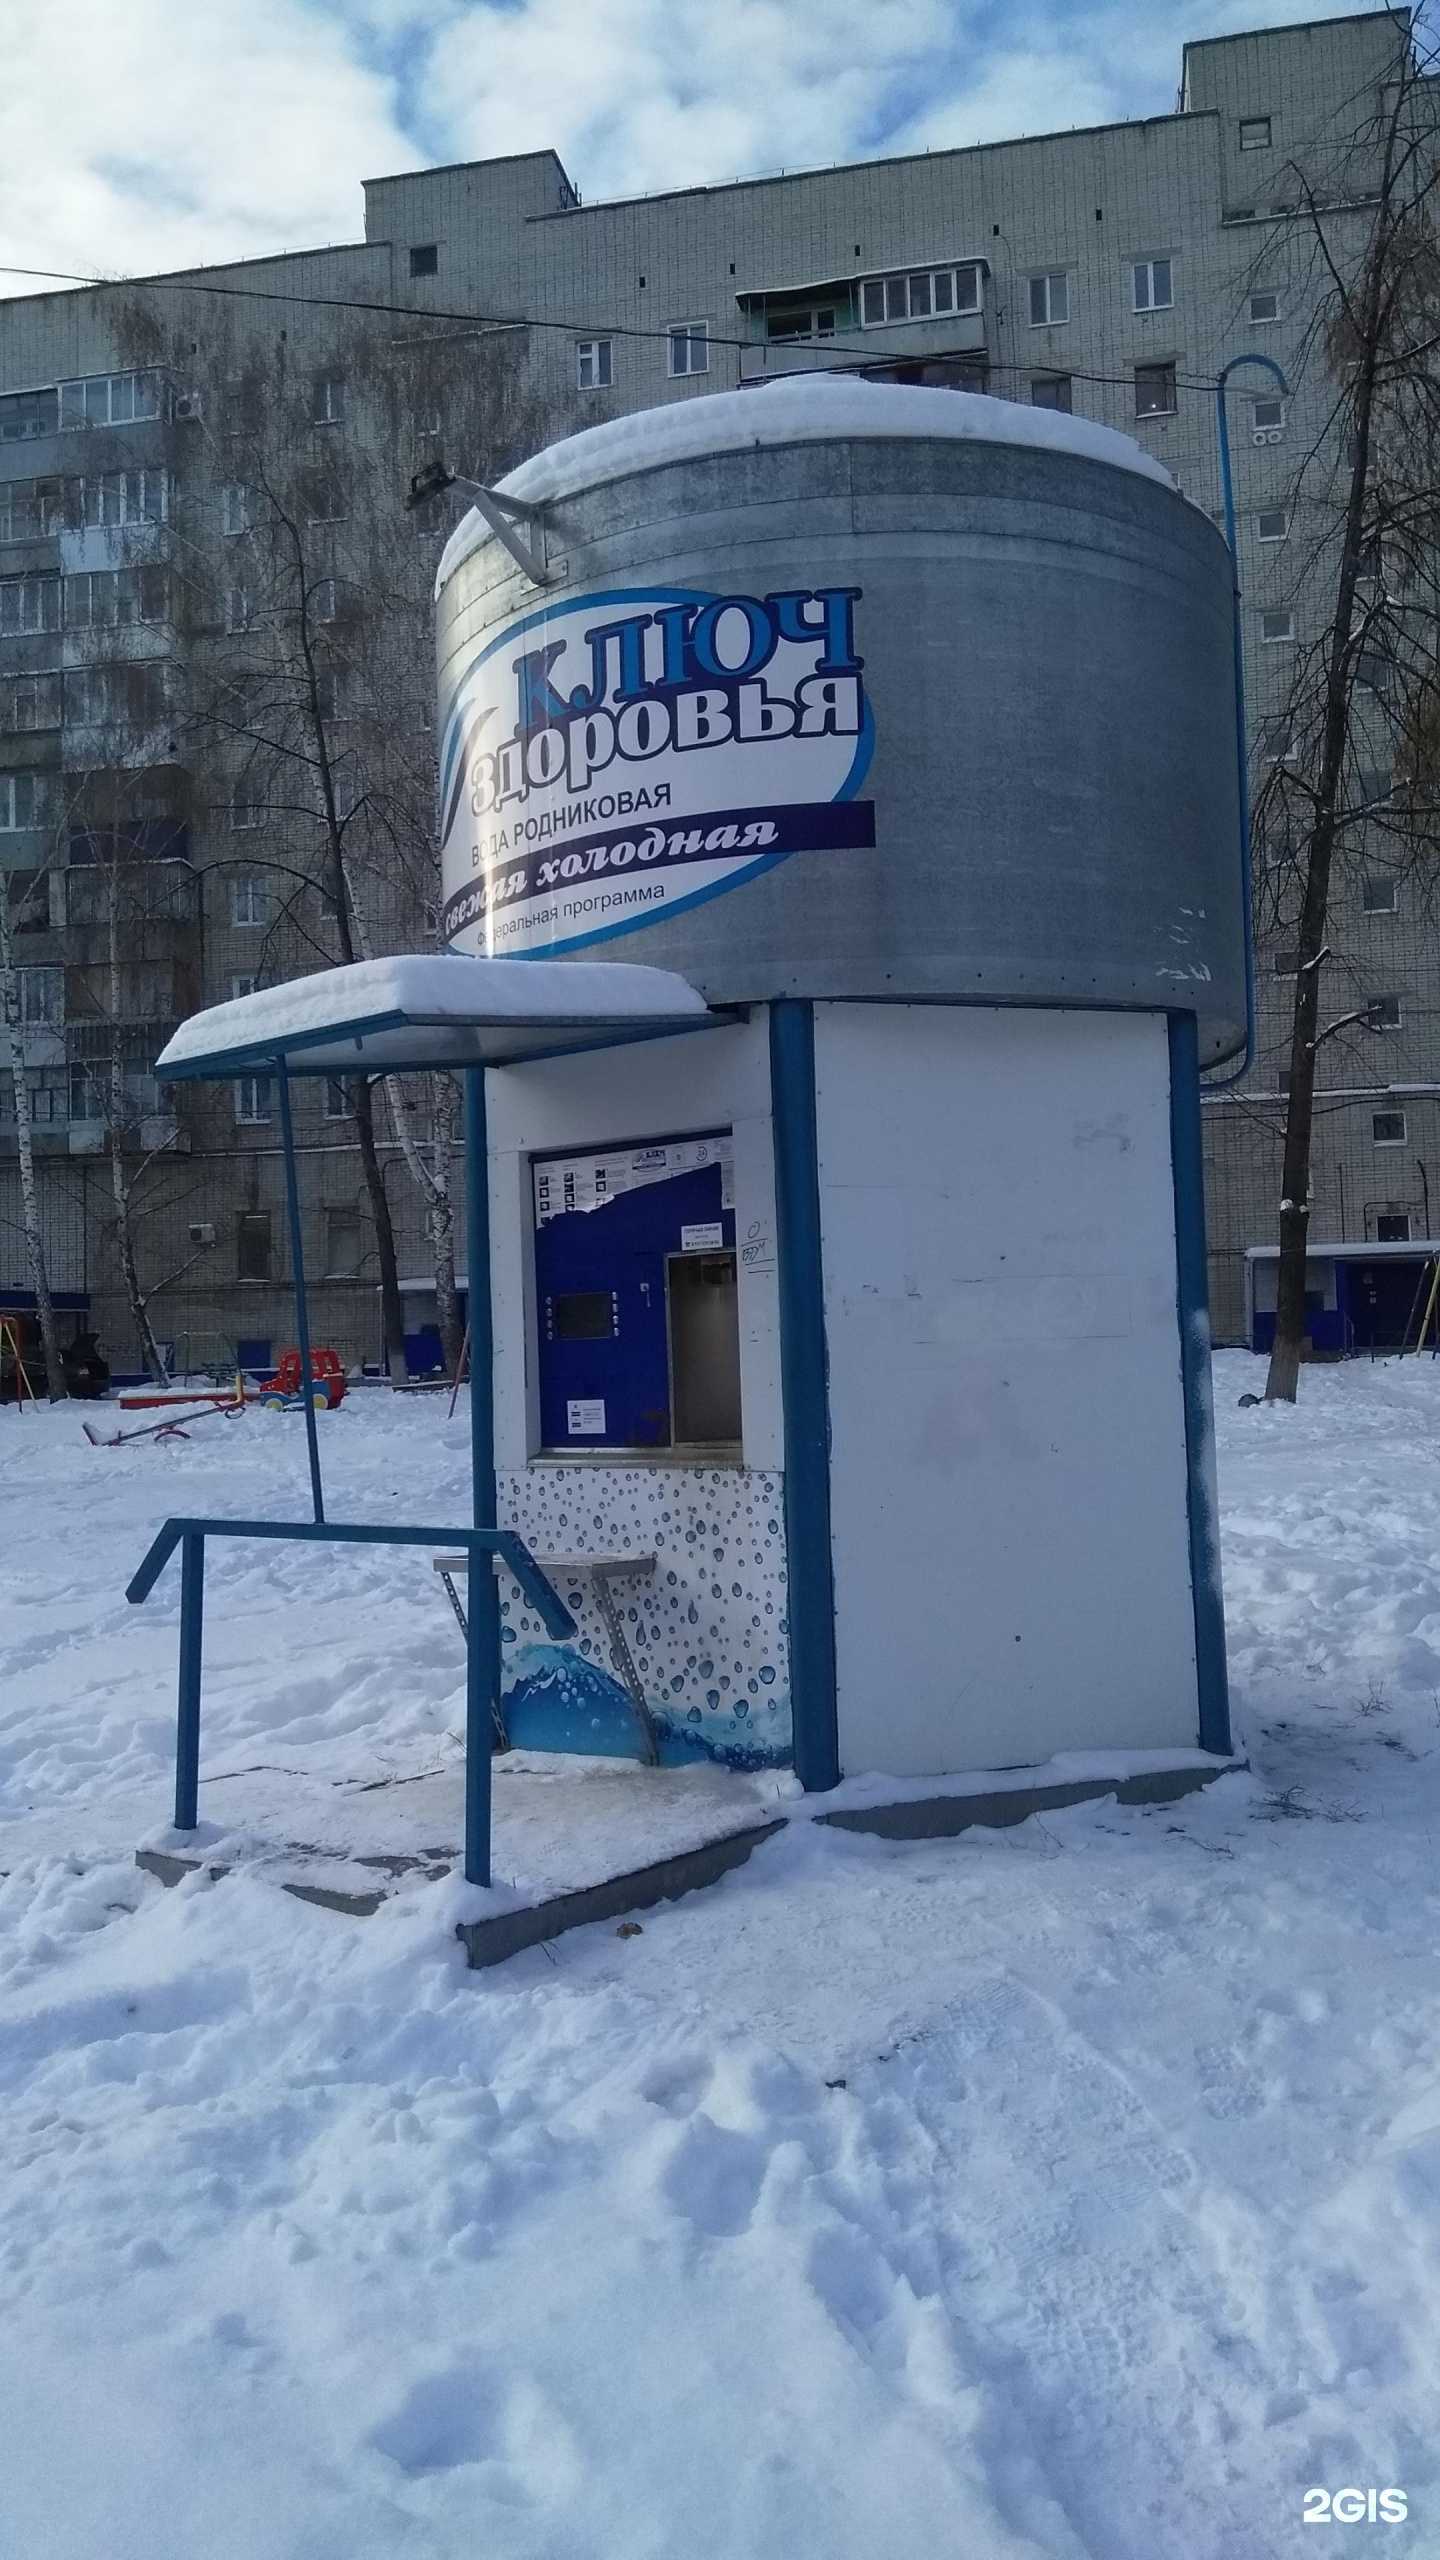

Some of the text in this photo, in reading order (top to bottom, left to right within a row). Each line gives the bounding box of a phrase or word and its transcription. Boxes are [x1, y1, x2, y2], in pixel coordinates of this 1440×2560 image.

[513, 587, 864, 733] КЛЮЧ
[471, 672, 863, 817] здоровья
[472, 783, 671, 867] ВОДА РОДНИКОВАЯ
[536, 820, 779, 887] холодная
[477, 883, 665, 946] Феральная программа
